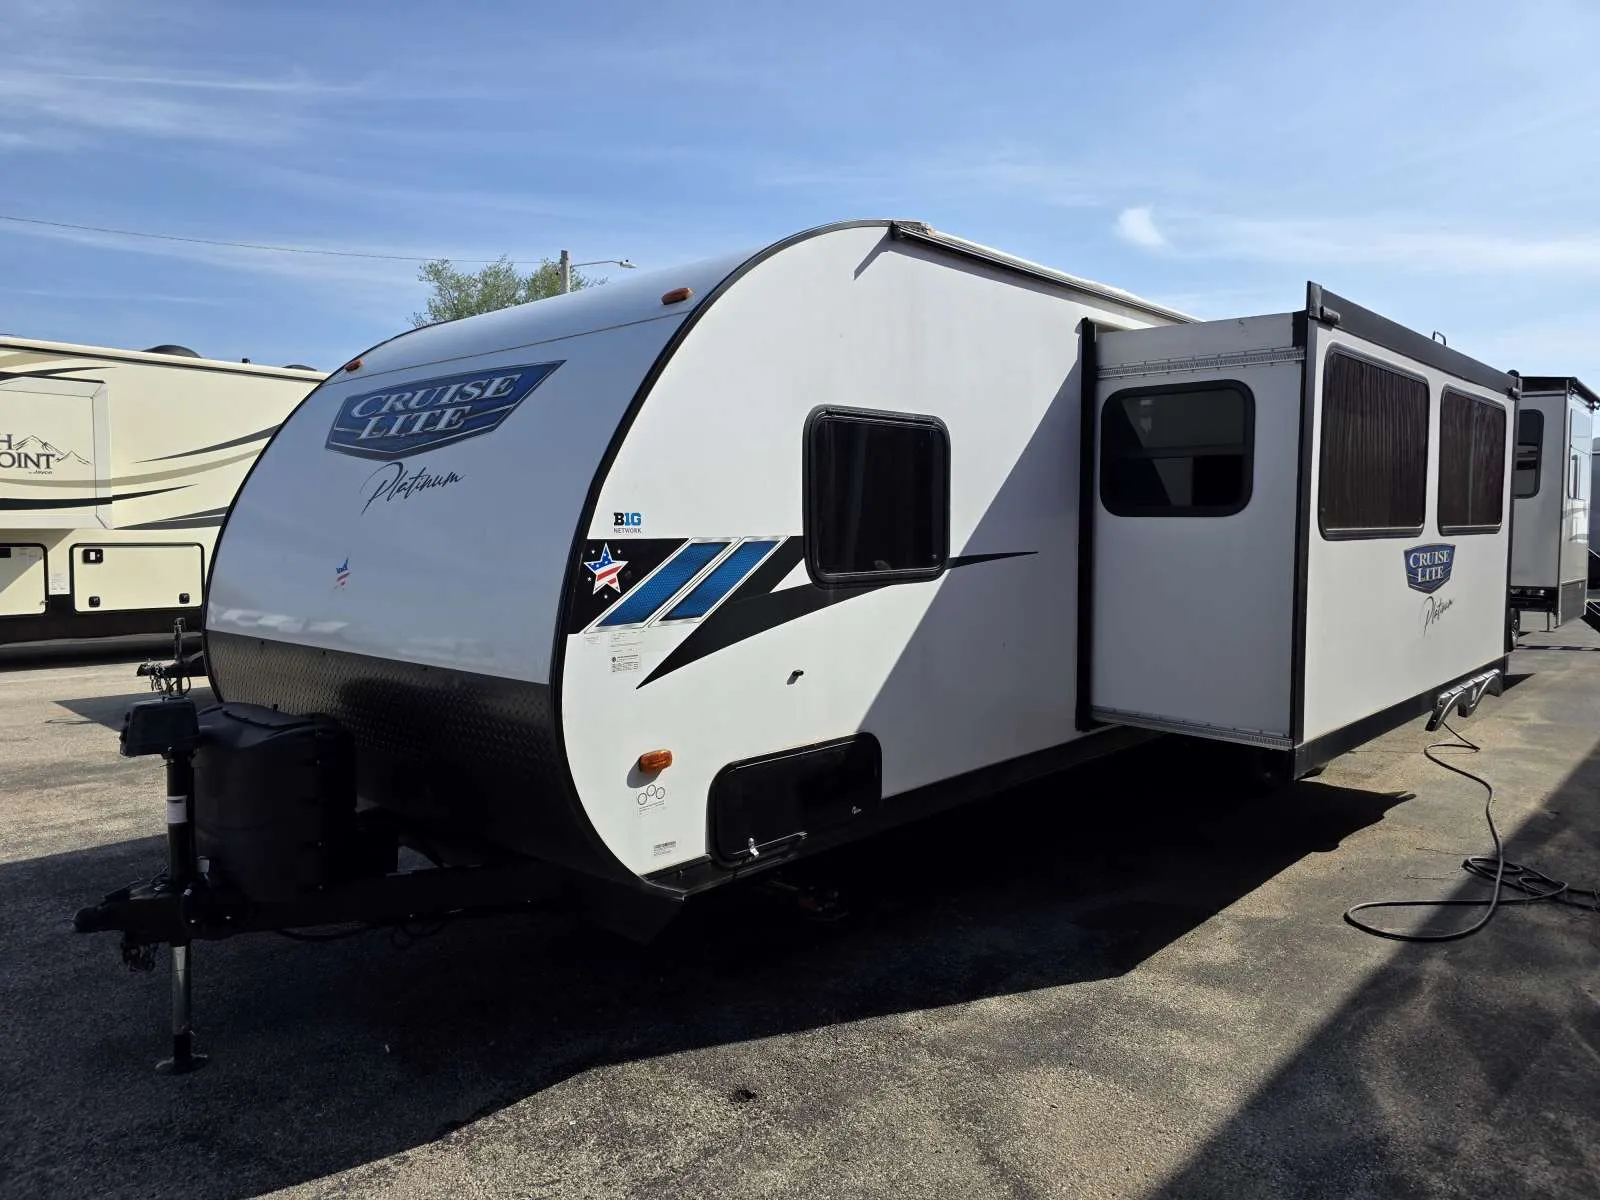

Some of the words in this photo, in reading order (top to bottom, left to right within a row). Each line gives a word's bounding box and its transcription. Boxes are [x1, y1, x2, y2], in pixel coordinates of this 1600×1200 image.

[350, 374, 522, 418] CRUISE
[356, 405, 473, 440] LITE
[360, 461, 466, 516] Platinum
[1409, 550, 1450, 568] CRUISE
[1418, 566, 1444, 582] LITE
